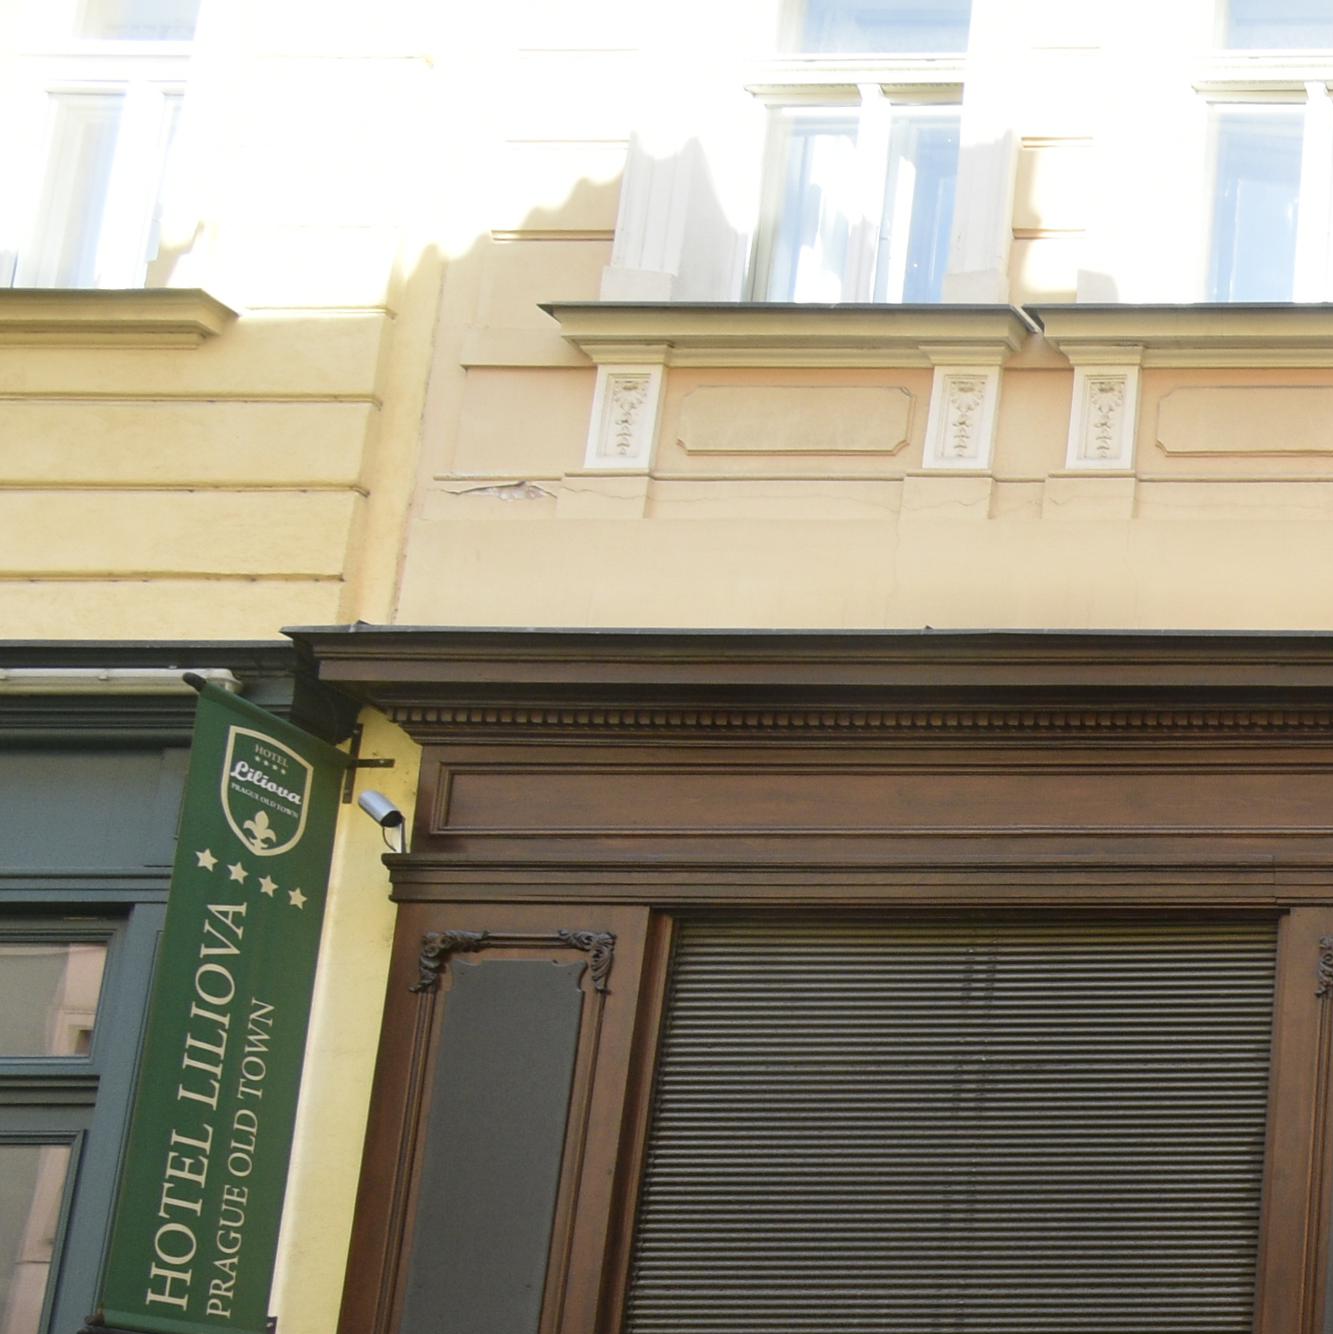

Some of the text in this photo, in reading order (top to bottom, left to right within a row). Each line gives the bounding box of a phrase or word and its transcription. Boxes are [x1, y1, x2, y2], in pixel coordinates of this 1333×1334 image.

[230, 760, 302, 805] Liliova
[255, 744, 289, 768] HOTEL
[146, 901, 247, 1311] HOTEL LILIOVA
[206, 996, 275, 1319] PRAGUE OLD TOWN
